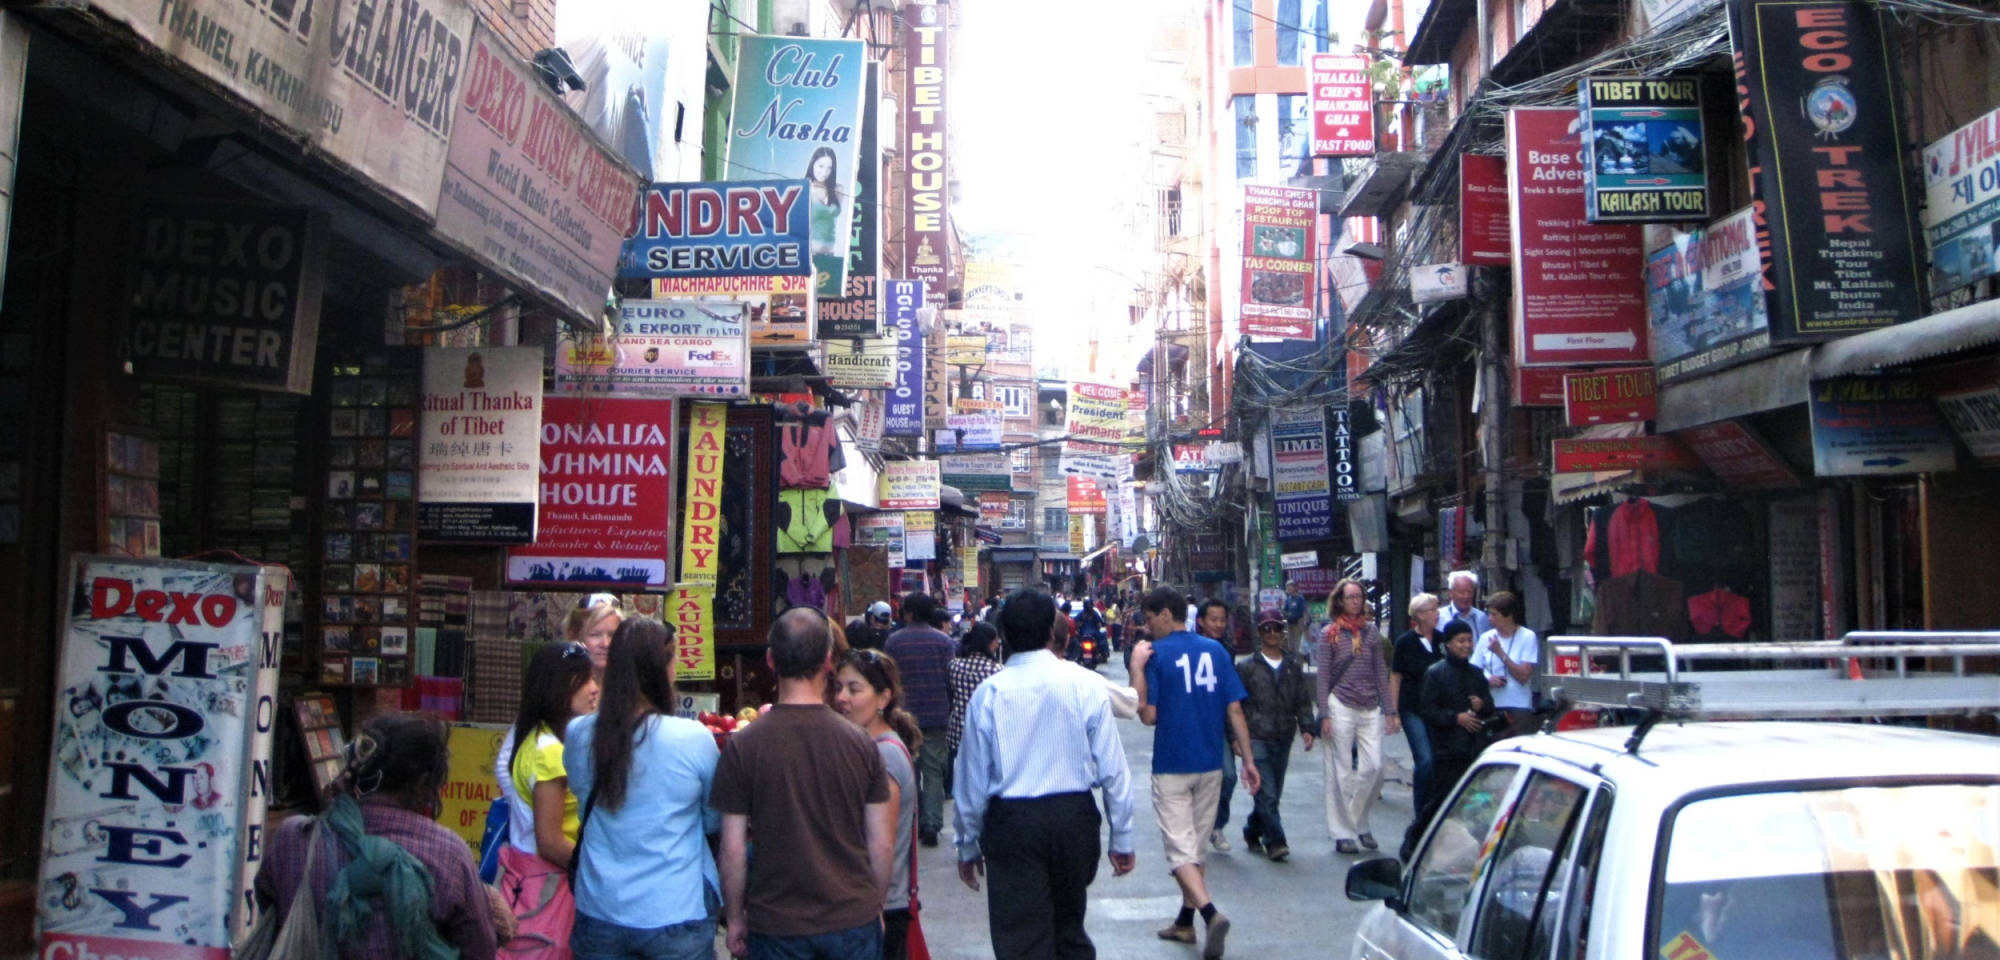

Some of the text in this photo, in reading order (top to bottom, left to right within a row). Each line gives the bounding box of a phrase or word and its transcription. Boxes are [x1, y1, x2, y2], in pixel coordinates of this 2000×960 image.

[1795, 8, 1852, 72] ECO
[766, 44, 843, 88] Club
[1592, 81, 1695, 100] TIBET TOUR
[465, 41, 527, 144] DEXO
[522, 96, 582, 191] MUSIC
[736, 94, 851, 143] Nasha
[1324, 114, 1360, 125] GHAR
[912, 26, 944, 231] TIBET HOUSE
[1315, 140, 1373, 151] FAST FOOD
[1528, 151, 1570, 164] Base
[1524, 186, 1546, 195] Treks
[1812, 146, 1874, 233] TREK
[487, 148, 593, 250] World Music Collection
[1292, 200, 1315, 209] GHAR
[1600, 191, 1704, 212] KAILASH TOUR
[1255, 205, 1305, 216] ROOF TOP
[1246, 214, 1313, 227] RESTAURANT
[145, 214, 294, 272] DEXO
[1829, 239, 1871, 248] Nepal
[647, 243, 800, 271] SERVICE
[1818, 249, 1883, 259] Trekking
[911, 266, 944, 274] Thanka
[1266, 259, 1313, 273] CORNER
[1835, 260, 1868, 268] Tour
[1834, 270, 1872, 279] Tibet
[780, 273, 807, 293] SPA
[1814, 280, 1895, 290] Mt. Kailash
[136, 269, 288, 320] MUSIC
[1830, 291, 1882, 300] Bhutan
[819, 300, 876, 321] HOUSE
[1838, 301, 1875, 309] India
[622, 307, 686, 319] EURO
[622, 323, 634, 335] &
[639, 323, 703, 335] EXPORT
[135, 318, 282, 368] CENTER
[618, 338, 713, 346] LAND SEA CARGO
[688, 350, 733, 361] FedEx
[828, 353, 891, 367] Handicraft
[654, 368, 697, 376] SERVICE
[1570, 372, 1655, 402] TIBET TOUR
[470, 391, 533, 412] Thanka
[892, 403, 916, 415] GUEST
[1071, 405, 1124, 420] President
[440, 415, 505, 435] of Tibet
[885, 417, 909, 428] HOUSE
[1069, 420, 1122, 440] Marmaris
[1333, 410, 1353, 487] TATTOO
[690, 406, 720, 568] LAUNDRY
[541, 483, 638, 506] HOUSE
[1277, 500, 1330, 515] UNIQUE
[582, 512, 633, 521] Kathmandu
[1278, 516, 1331, 527] Money
[1279, 526, 1331, 538] Exchange
[609, 541, 661, 551] Retailer
[684, 572, 718, 581] SERVICE
[1288, 569, 1326, 582] UNITED
[91, 577, 237, 628] Dexo
[677, 589, 704, 669] LAUNDRY
[1175, 652, 1218, 693] 14
[88, 635, 220, 932] MONEY
[440, 782, 493, 802] RITUAL
[459, 808, 478, 827] OF
